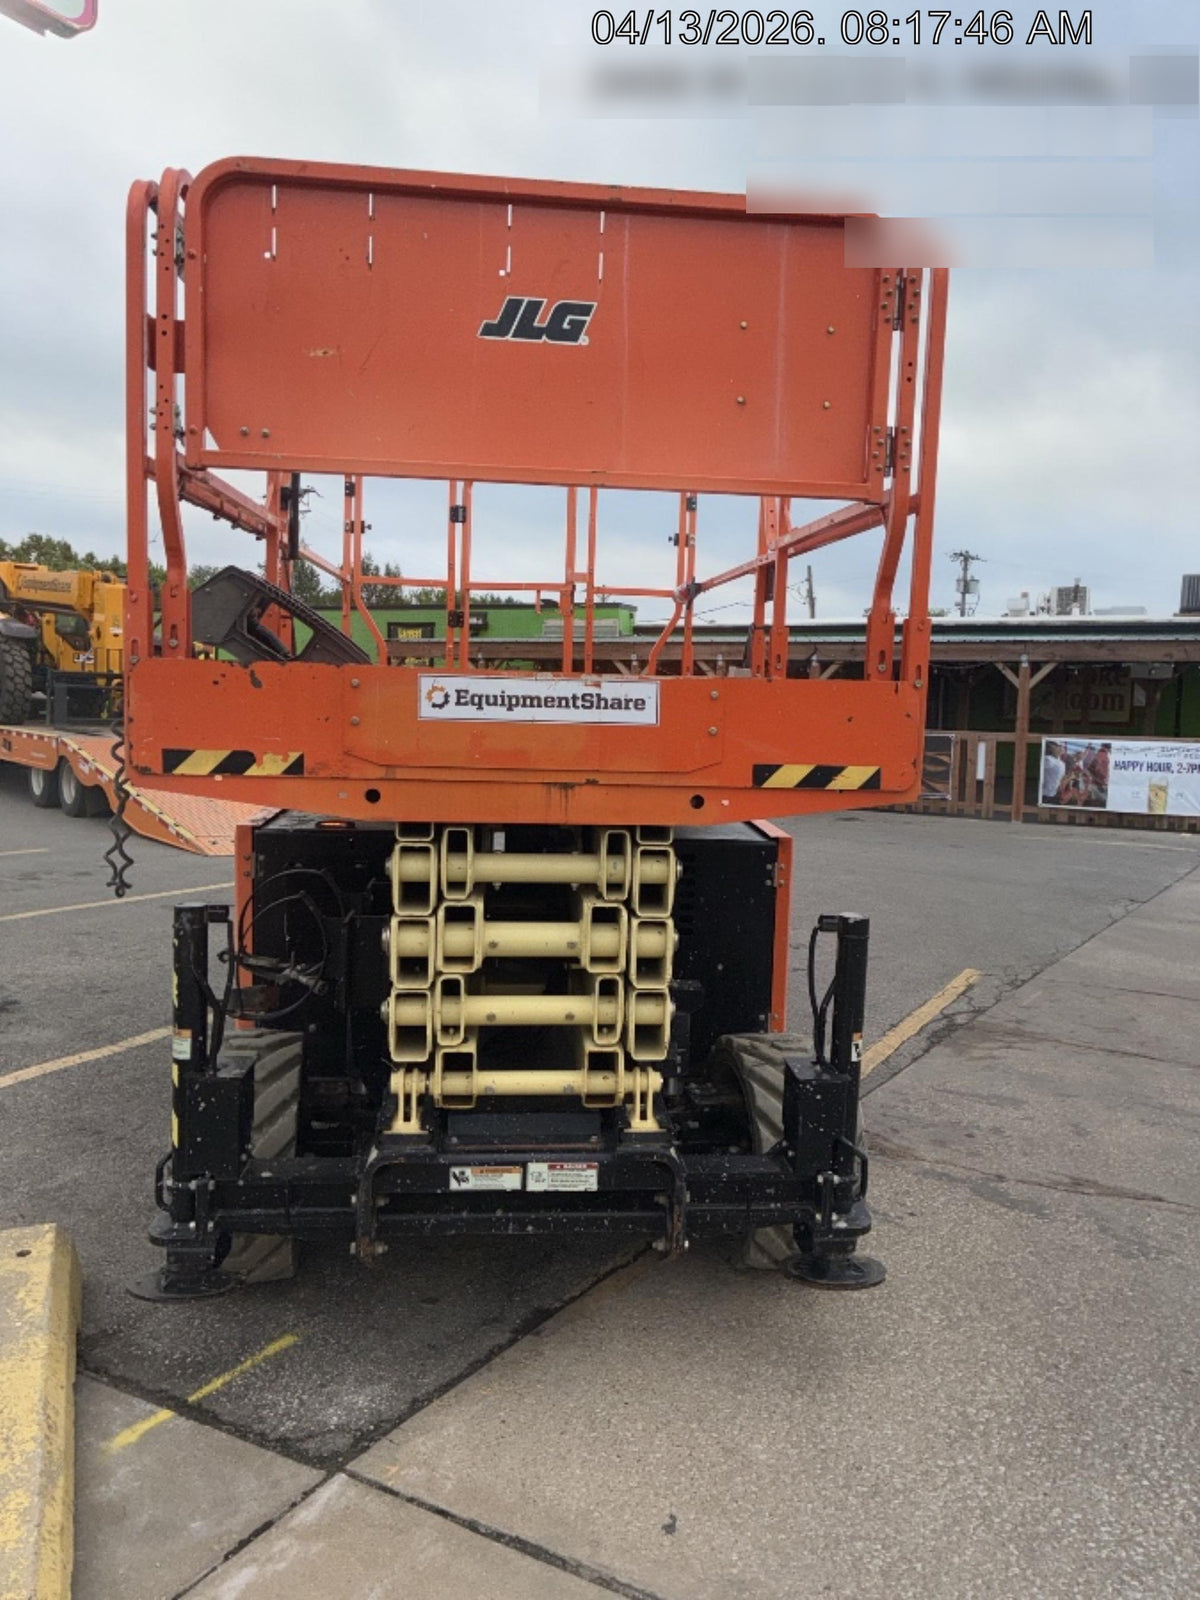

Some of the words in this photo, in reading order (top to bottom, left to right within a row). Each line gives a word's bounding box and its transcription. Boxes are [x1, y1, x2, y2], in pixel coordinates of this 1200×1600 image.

[477, 295, 598, 345] JLG
[454, 689, 647, 712] EquipmentShare
[1113, 760, 1144, 772] HAPPY
